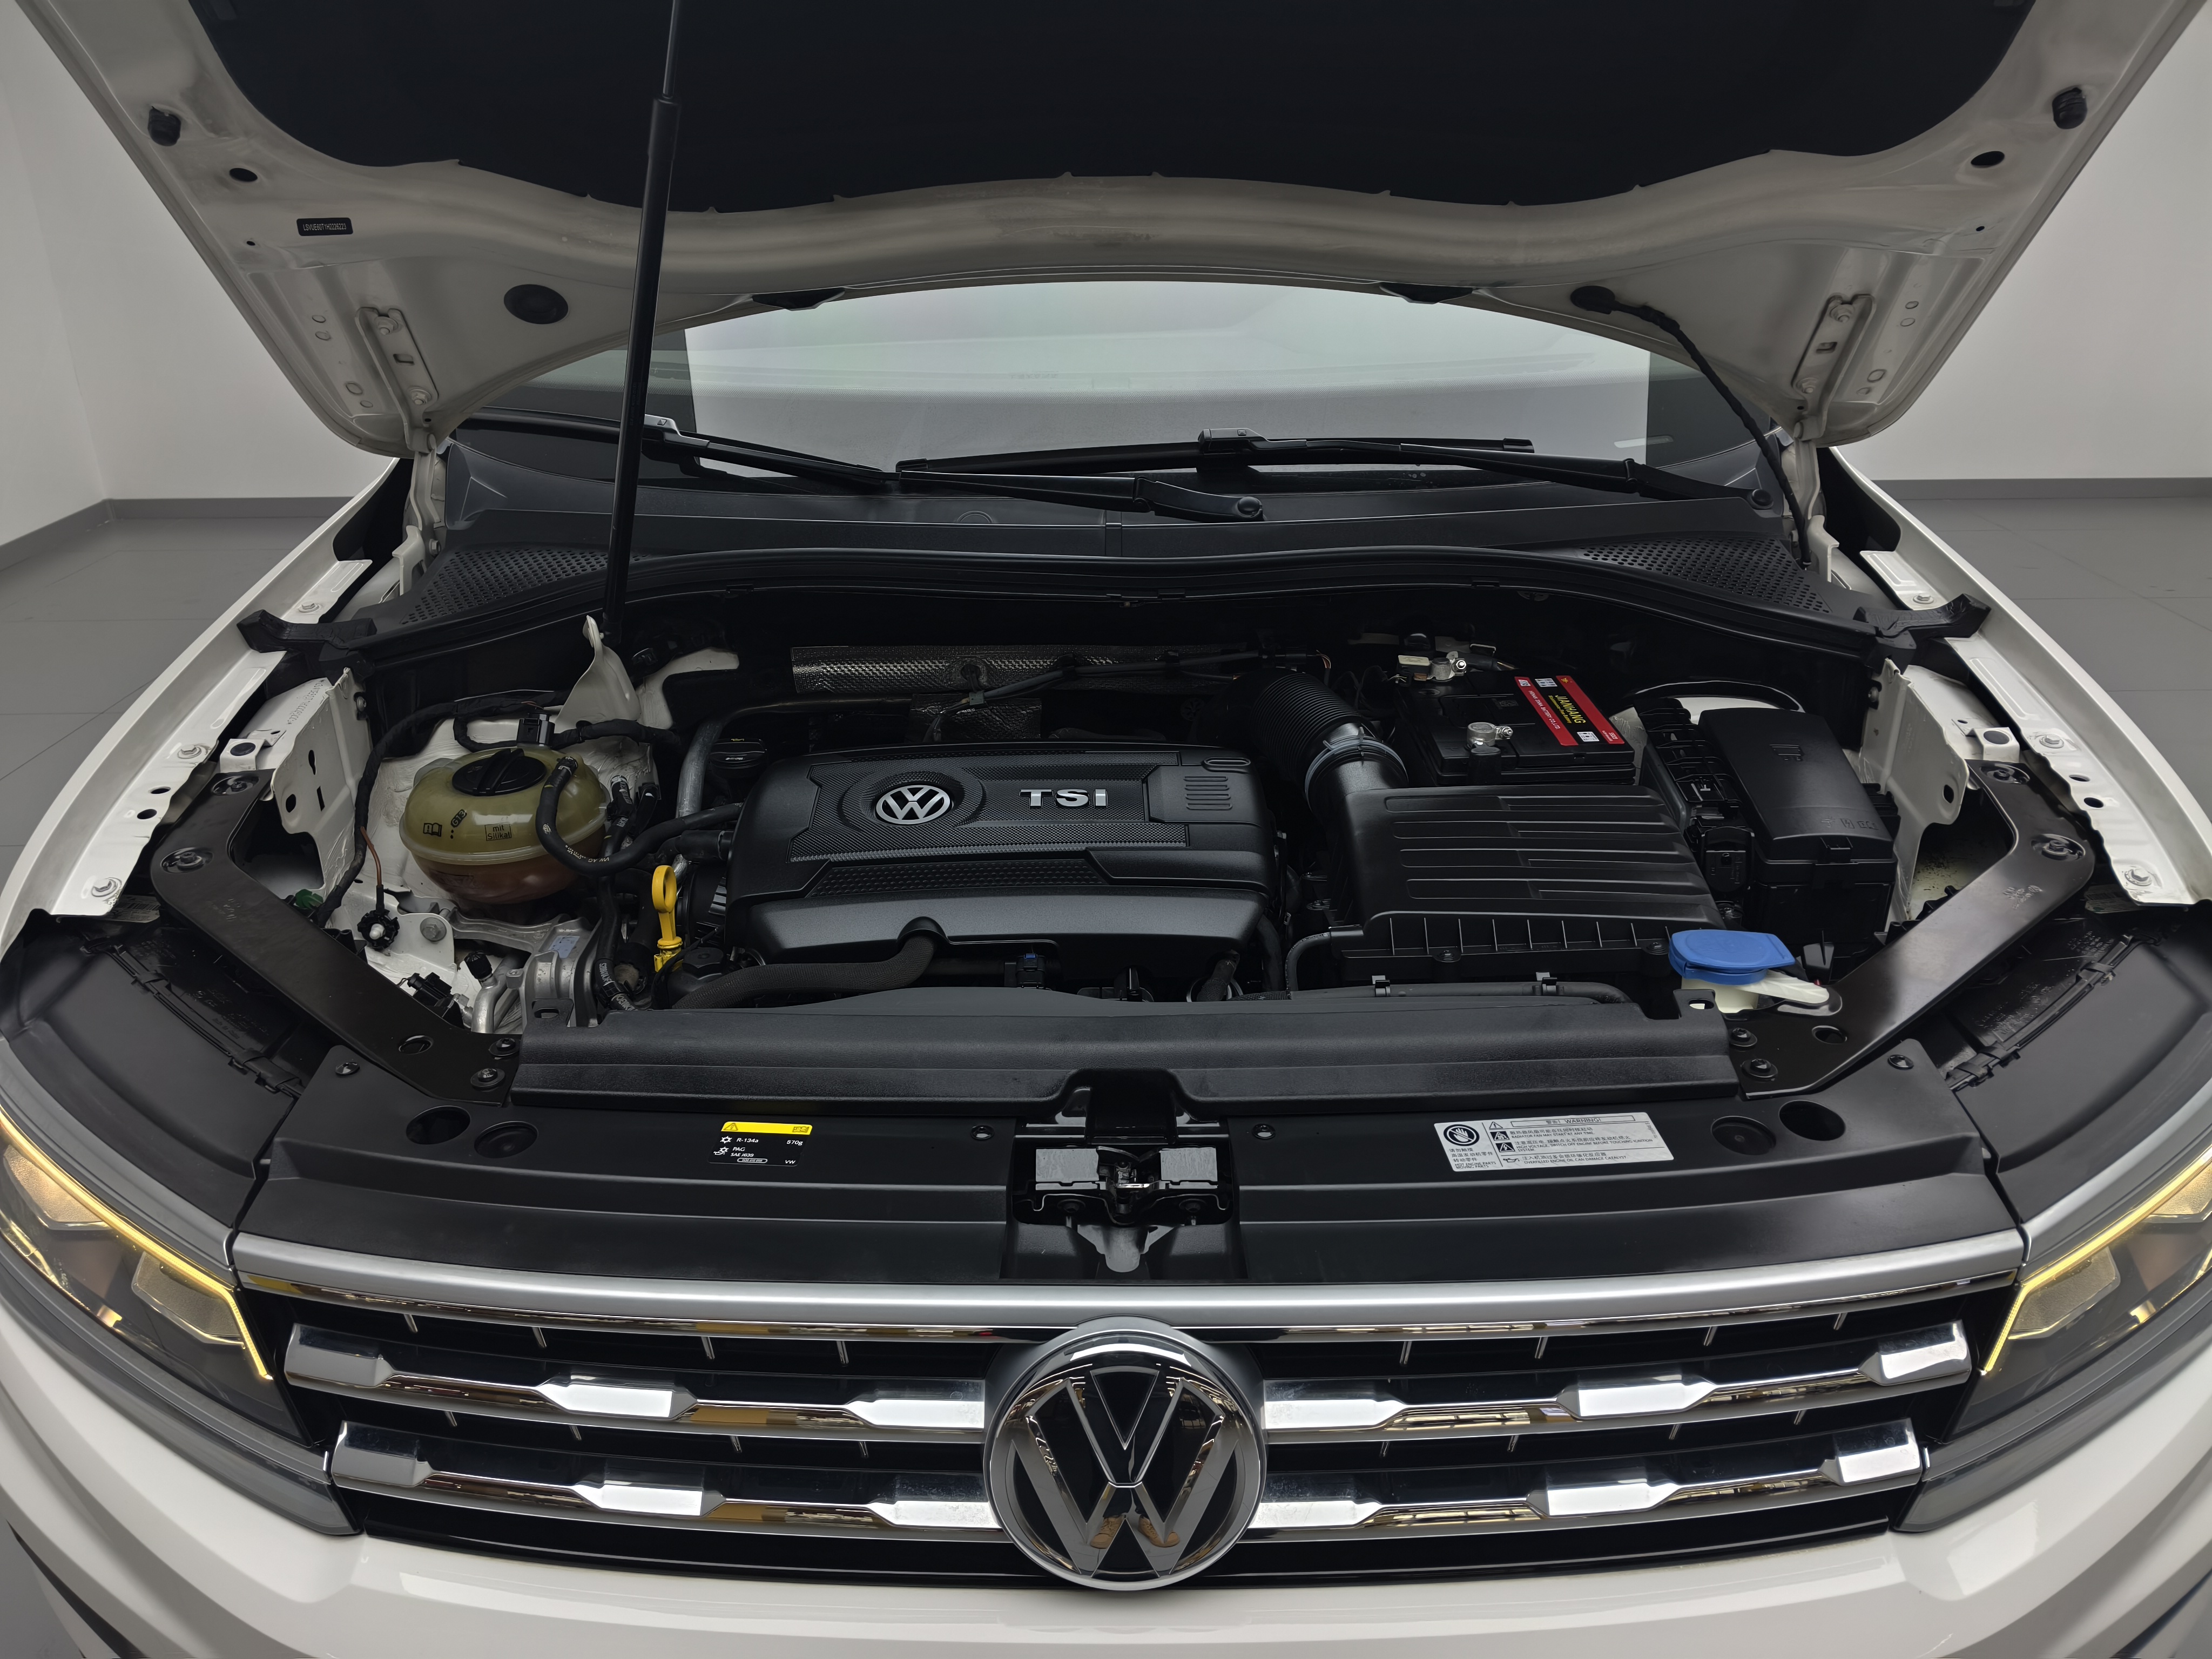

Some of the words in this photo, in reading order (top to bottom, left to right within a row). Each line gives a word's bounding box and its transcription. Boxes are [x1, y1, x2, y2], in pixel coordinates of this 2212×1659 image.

[1555, 695, 1586, 723] JIANHANG
[1020, 788, 1109, 808] TSI
[451, 810, 466, 827] G13
